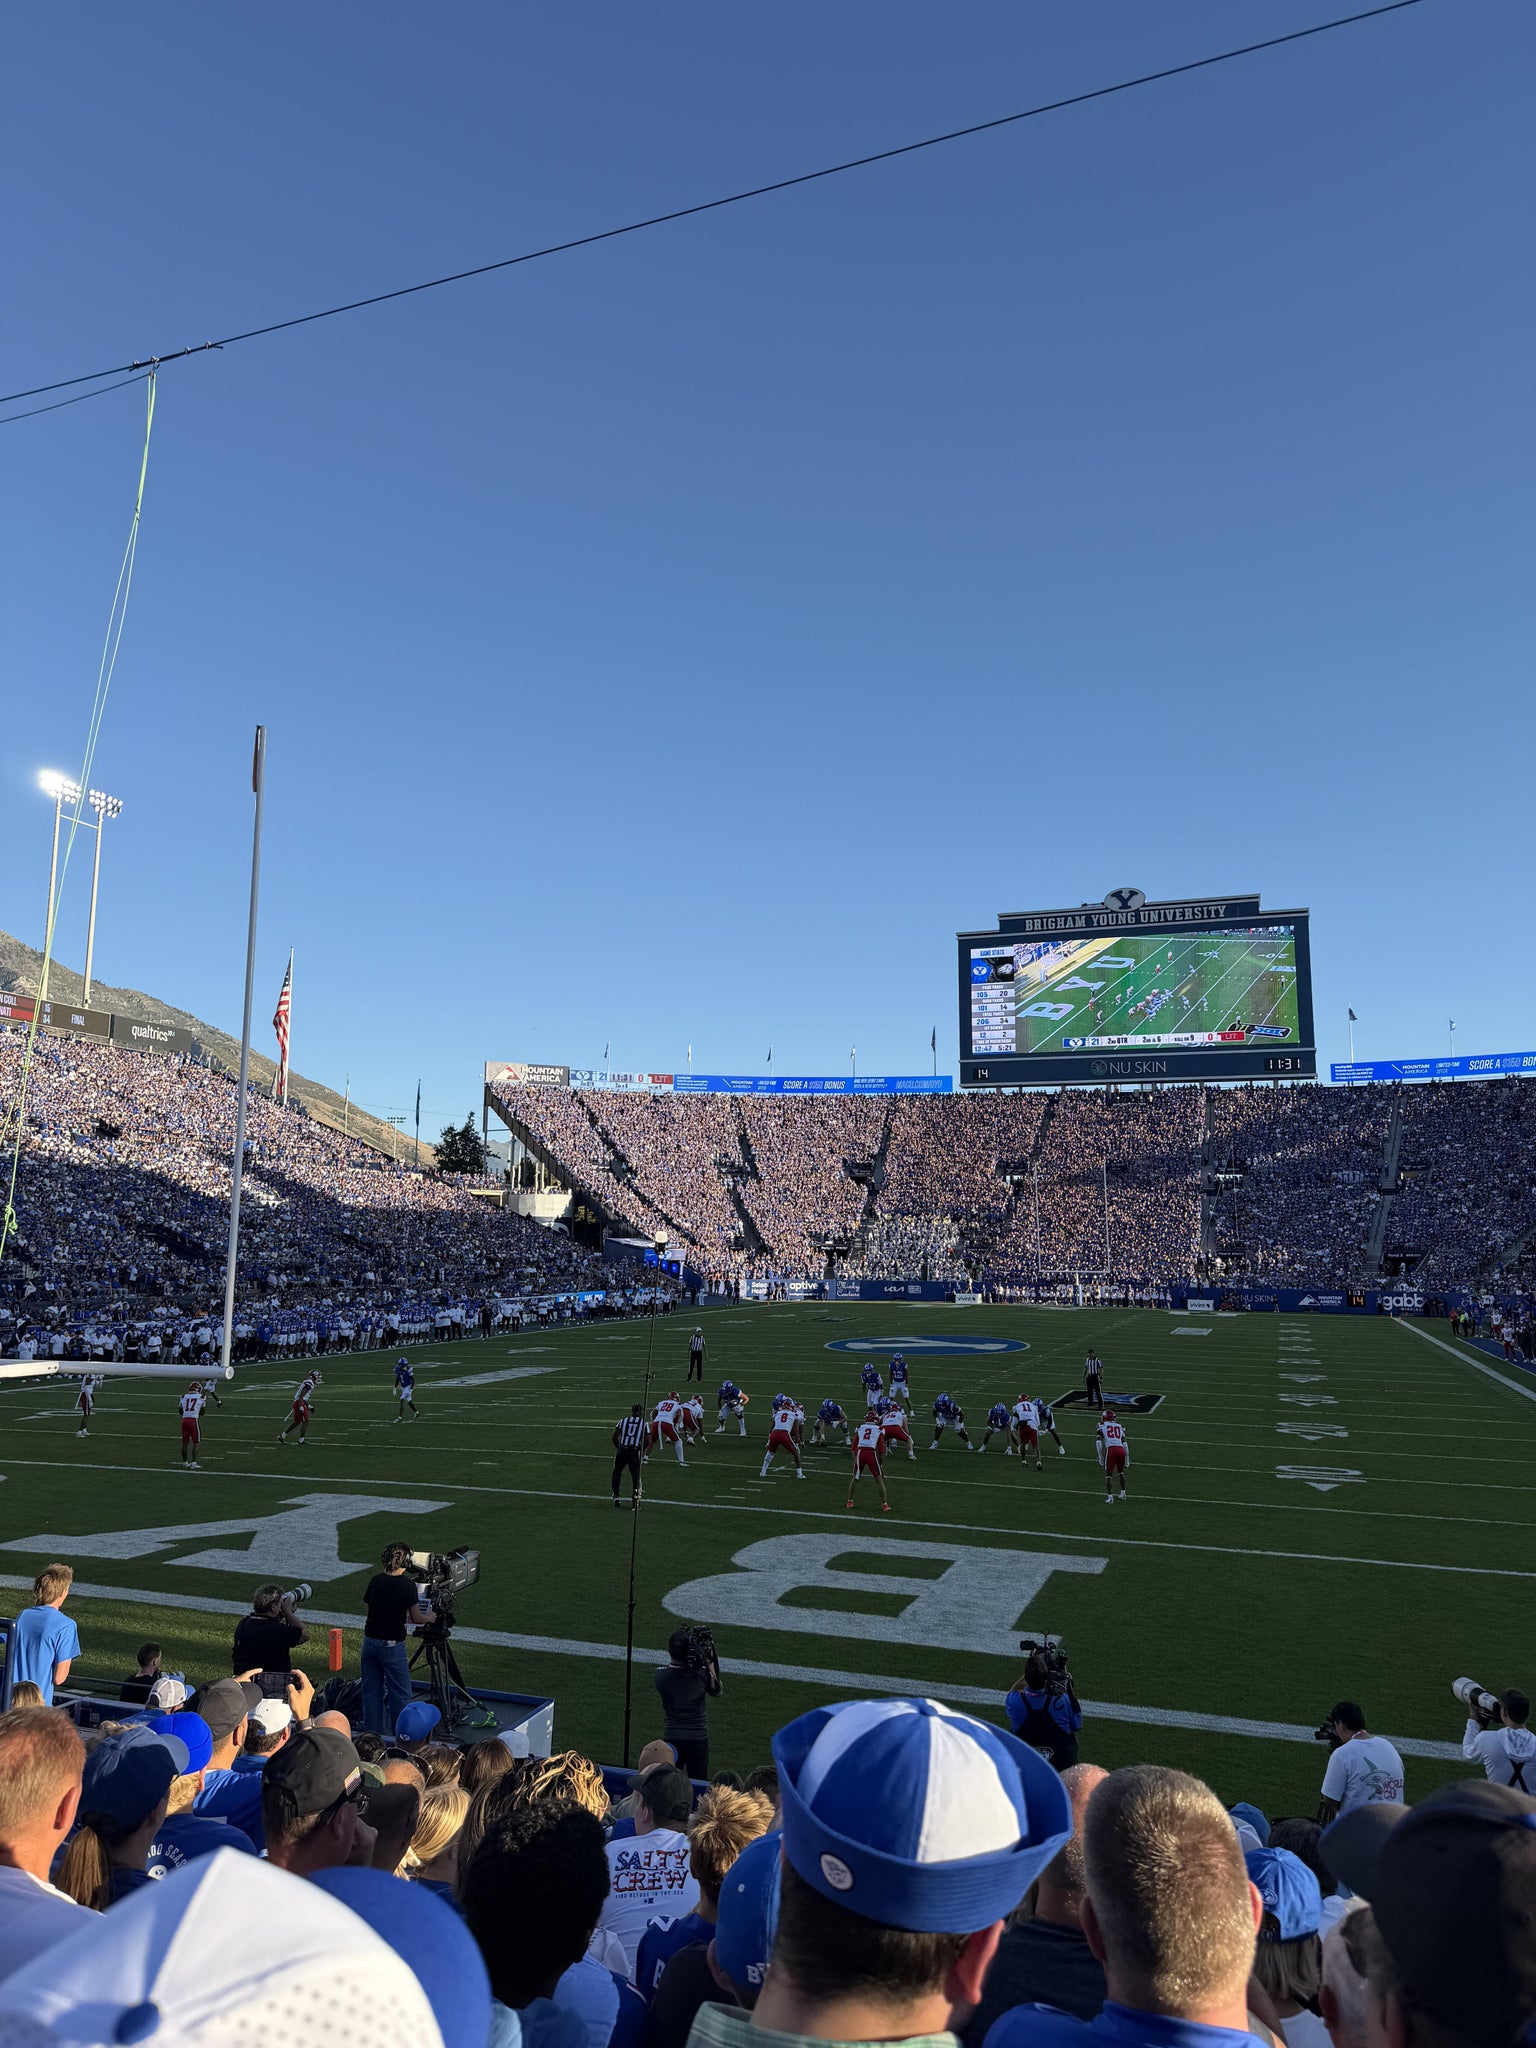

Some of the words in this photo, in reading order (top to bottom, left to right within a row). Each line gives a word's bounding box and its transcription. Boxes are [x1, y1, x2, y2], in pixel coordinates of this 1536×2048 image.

[1025, 915, 1086, 932] BRIGHAM
[1090, 911, 1136, 927] YOUNG
[1139, 905, 1227, 923] UNIVERSITY
[71, 1013, 86, 1026] FINAL
[131, 1024, 168, 1042] qualtrics
[1207, 1033, 1213, 1041] 0
[1110, 1062, 1131, 1075] NU
[1135, 1060, 1167, 1074] SKIN
[1269, 1058, 1301, 1070] 11:31
[1469, 1059, 1494, 1071] SCORE
[1494, 1059, 1500, 1069] A
[524, 1074, 561, 1083] AMERICA
[599, 1073, 608, 1081] 21
[612, 1074, 633, 1082] 11:31
[977, 1068, 988, 1079] 14
[783, 1080, 802, 1089] SCORE
[802, 1080, 808, 1089] A
[823, 1080, 846, 1089] BONUS
[789, 1280, 818, 1291] aptive
[1240, 1294, 1253, 1302] NU
[1254, 1294, 1273, 1303] SKIN
[1353, 1296, 1364, 1306] 14
[1383, 1293, 1424, 1311] gabb
[184, 1398, 198, 1412] 17
[659, 1402, 675, 1413] 28
[1021, 1403, 1032, 1412] 11
[780, 1412, 788, 1423] 8
[628, 1423, 638, 1437] U
[863, 1428, 872, 1440] 2
[1106, 1426, 1121, 1439] 20
[1381, 1778, 1404, 1791] WORL
[164, 1844, 188, 1869] SEAS
[614, 1848, 690, 1872] SALTY
[612, 1868, 690, 1893] CREW
